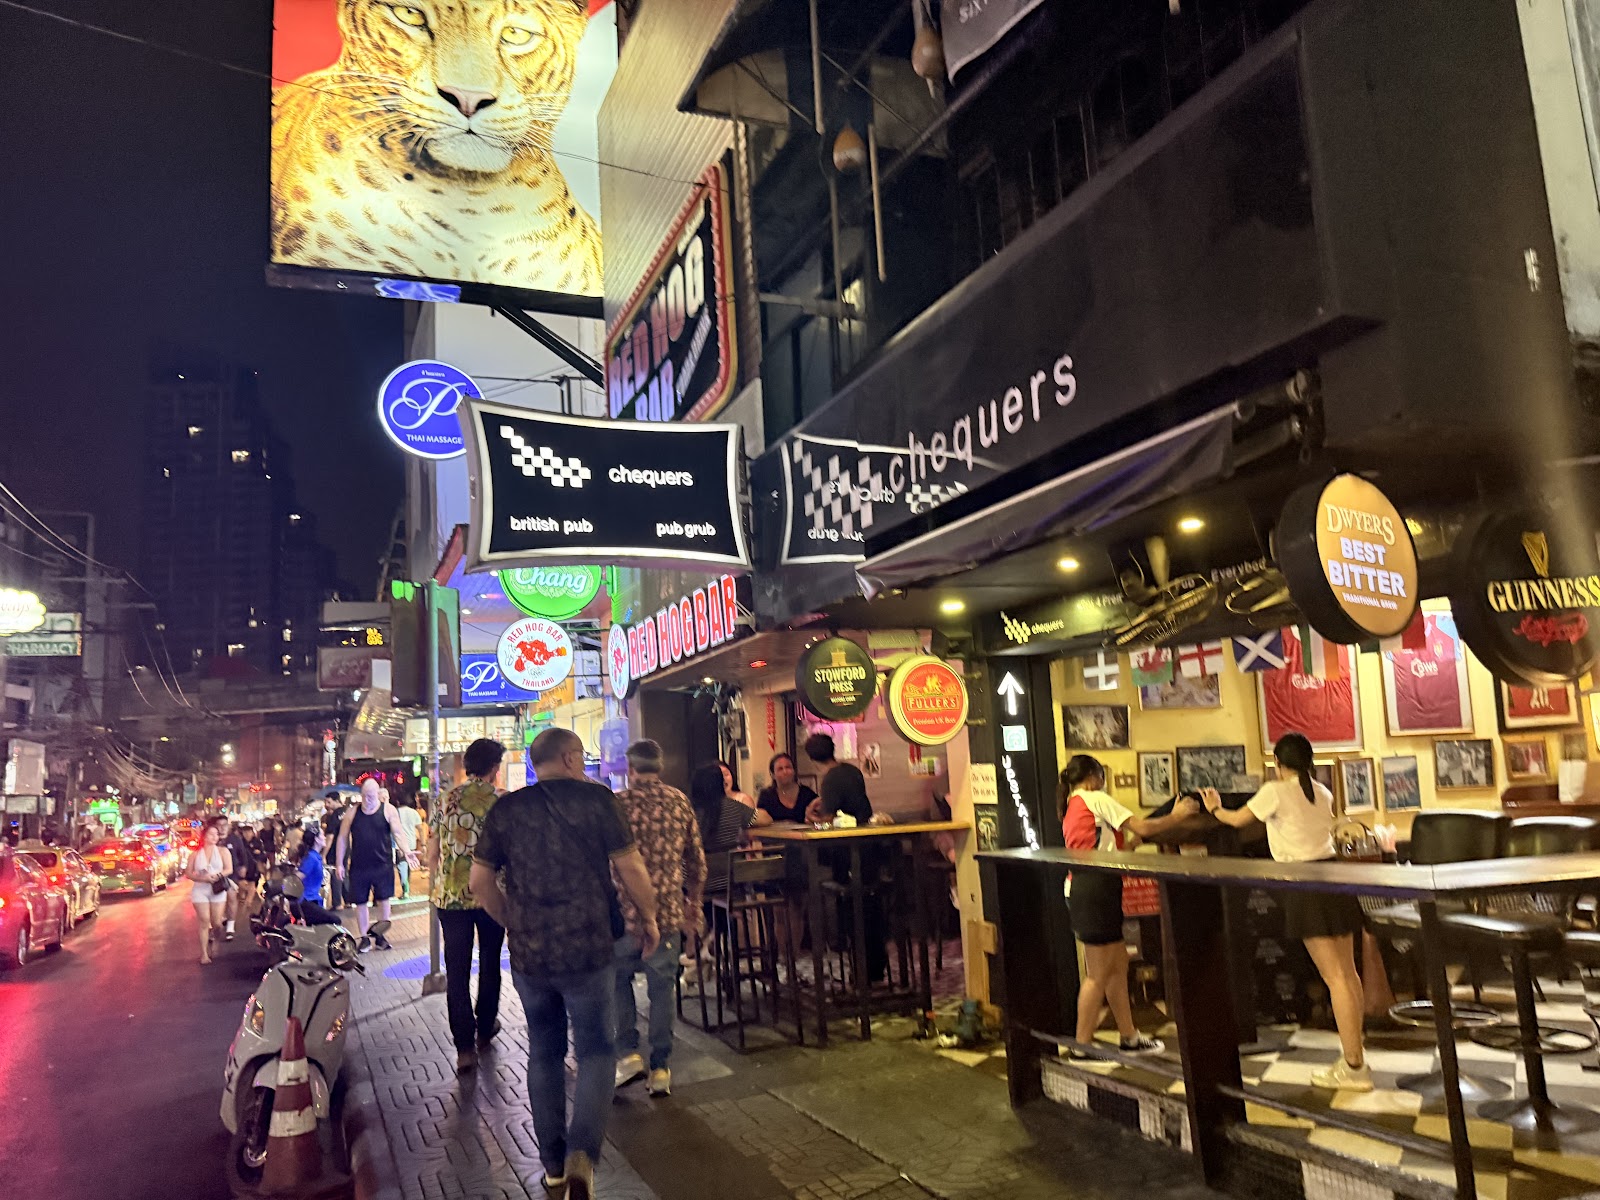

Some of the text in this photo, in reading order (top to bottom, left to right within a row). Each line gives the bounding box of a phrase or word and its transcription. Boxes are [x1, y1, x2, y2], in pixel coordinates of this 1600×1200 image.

[609, 319, 650, 420] RED
[650, 234, 706, 370] HOG
[889, 353, 1077, 493] chequers
[406, 433, 463, 444] THAI MASSAGE
[608, 464, 694, 489] chequers
[510, 515, 594, 535] british pub
[656, 521, 716, 539] pub grub
[1324, 502, 1396, 546] DWYERS
[1340, 536, 1386, 566] BEST
[1327, 559, 1407, 598] BITTER
[1487, 575, 1600, 613] GUINNESS
[507, 622, 564, 643] RED HOG BAR
[626, 573, 739, 681] RED HOG BAR
[814, 666, 866, 684] STOWFORD
[829, 680, 854, 694] PRESS
[1001, 754, 1040, 851] UPSTAIRS
